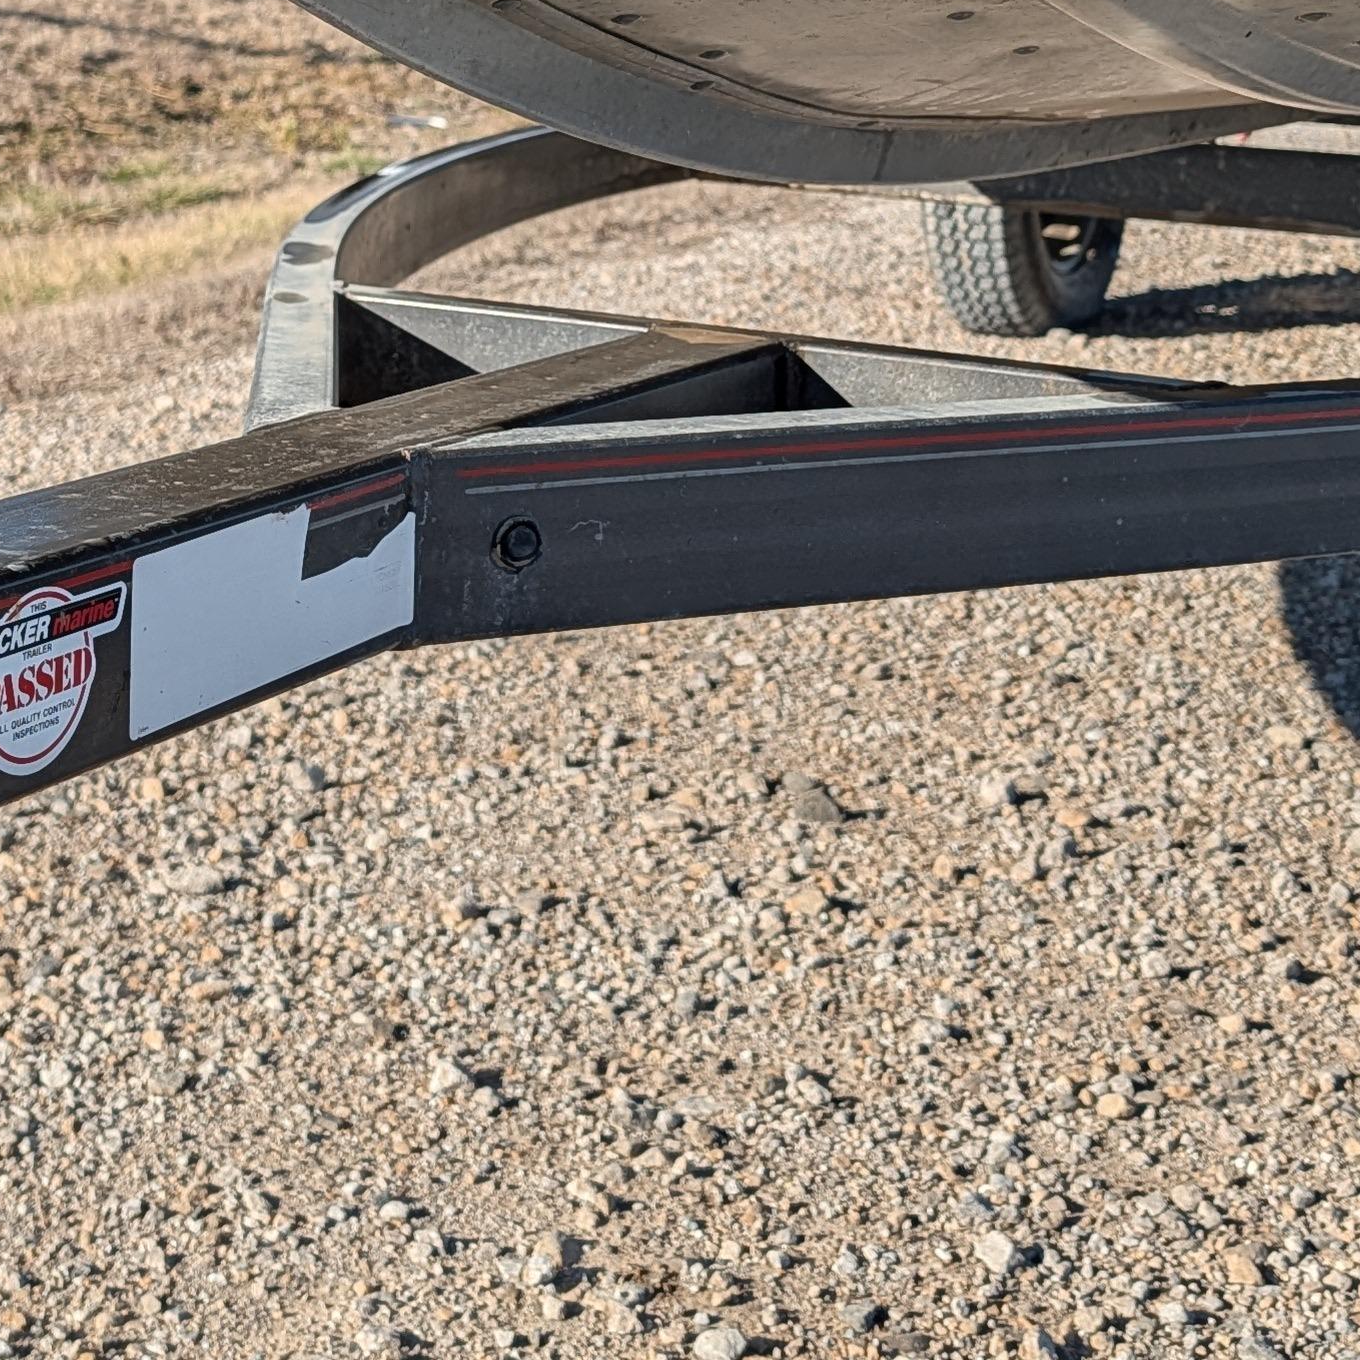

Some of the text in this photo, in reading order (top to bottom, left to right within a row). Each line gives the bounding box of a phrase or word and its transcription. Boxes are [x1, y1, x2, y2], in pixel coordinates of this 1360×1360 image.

[30, 601, 48, 614] THIS
[52, 599, 115, 636] marine
[22, 643, 53, 661] TRAILER
[11, 711, 41, 730] QUALITY
[42, 698, 75, 718] CONTROL
[12, 716, 60, 742] INSPECTIONS
